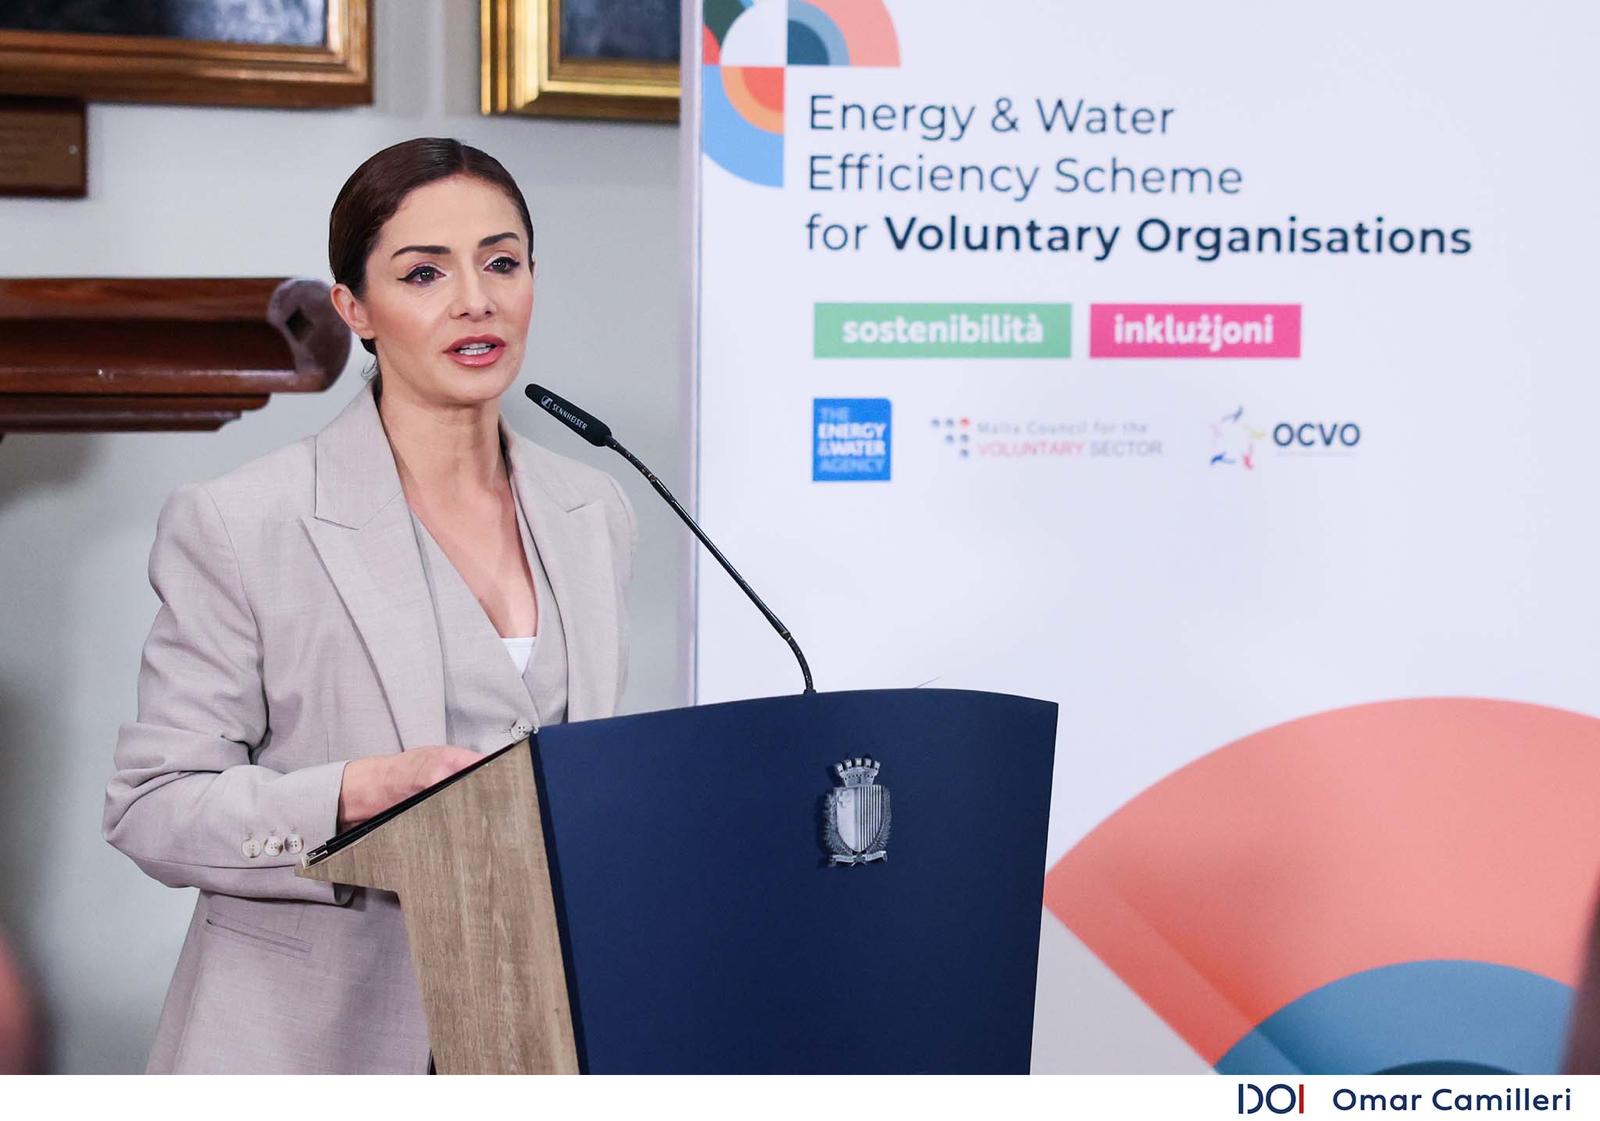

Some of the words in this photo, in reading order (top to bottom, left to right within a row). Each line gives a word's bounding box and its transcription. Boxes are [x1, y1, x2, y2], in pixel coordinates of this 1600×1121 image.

[809, 94, 976, 141] Energy
[991, 98, 1020, 134] &
[1035, 97, 1175, 135] Water
[809, 153, 1040, 201] Efficiency
[1055, 156, 1244, 194] Scheme
[805, 213, 868, 251] for
[884, 214, 1121, 260] Voluntary
[1136, 216, 1473, 261] Organisations
[842, 313, 1044, 345] sostenibilità
[1114, 312, 1275, 350] inklużjoni
[552, 403, 588, 430] SENNHEISER
[820, 407, 850, 420] THE
[819, 422, 886, 439] ENERGY
[1273, 423, 1361, 446] OCVO
[977, 441, 1083, 456] VOLUNTARY
[1090, 441, 1163, 456] SECTOR
[819, 459, 885, 474] AGENCY
